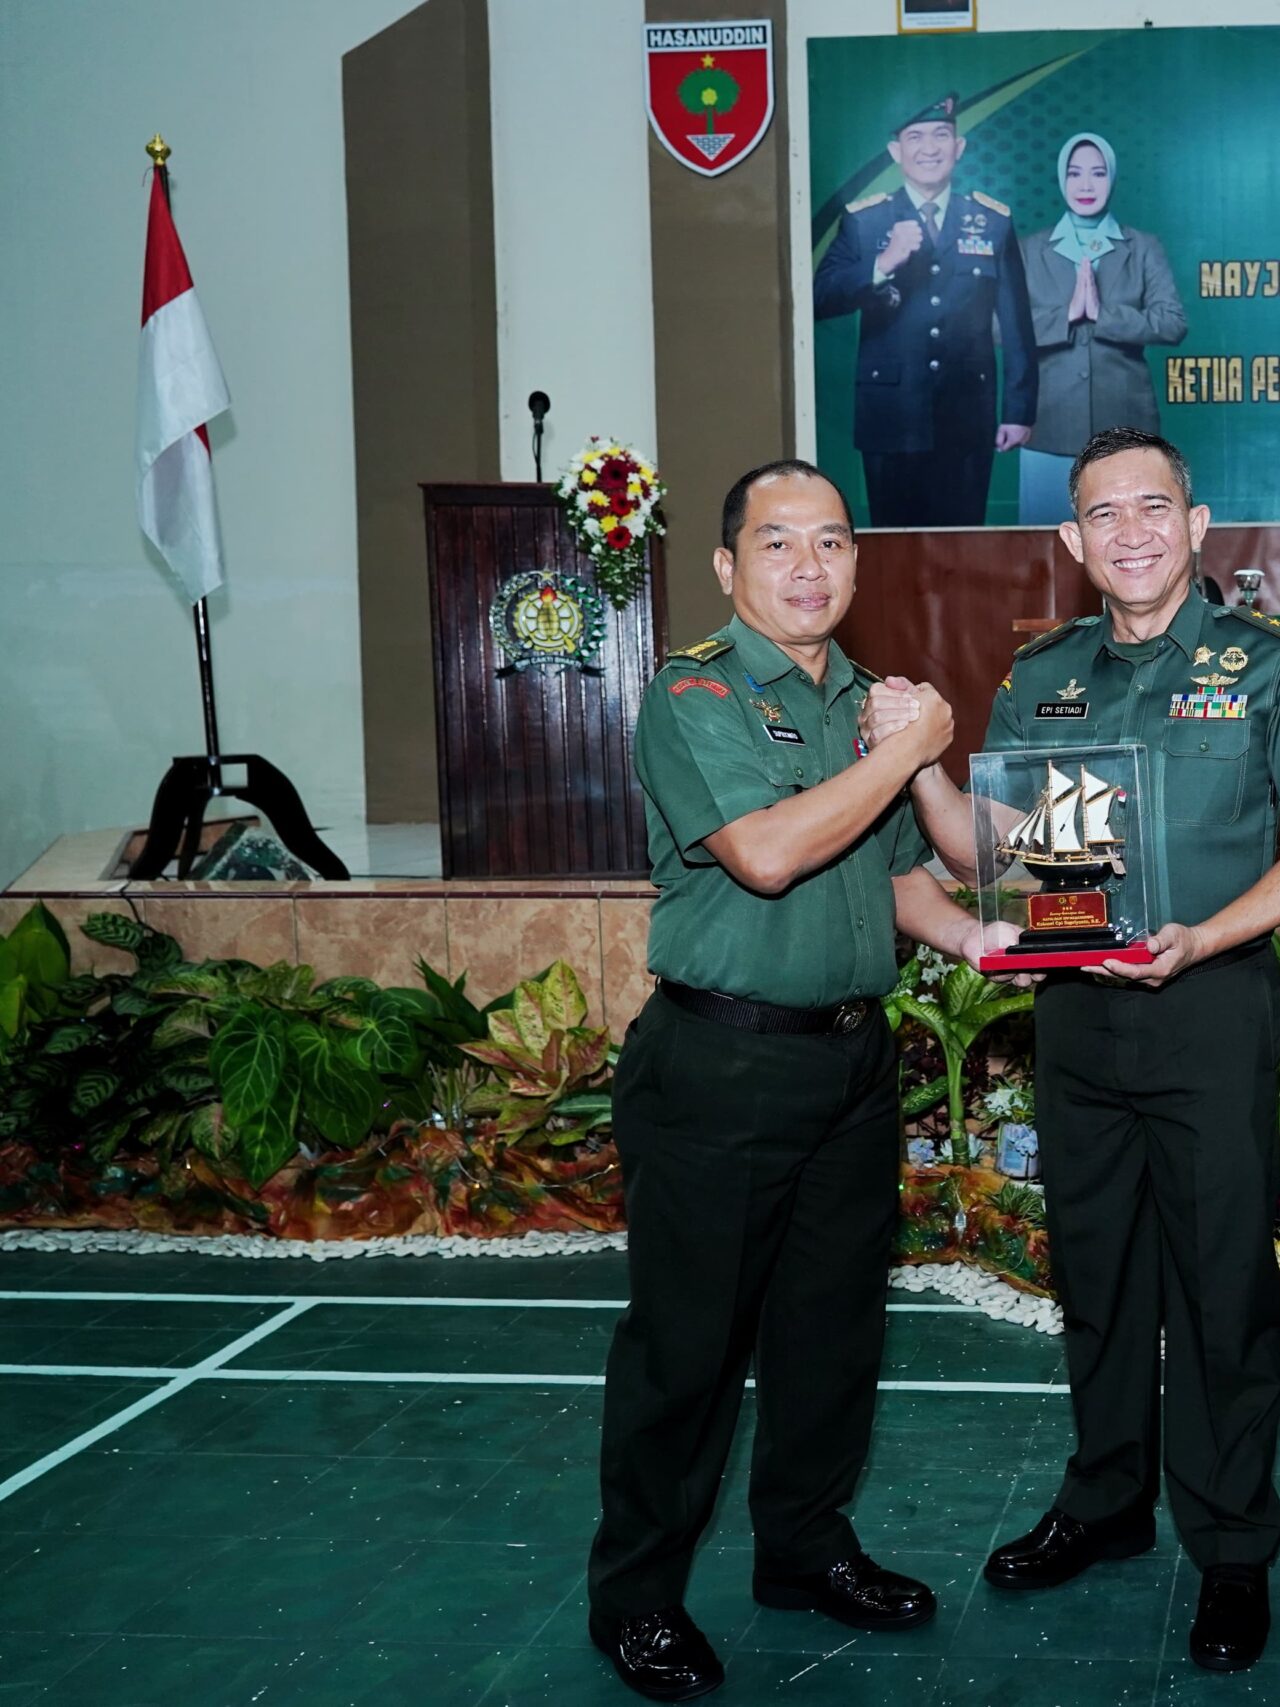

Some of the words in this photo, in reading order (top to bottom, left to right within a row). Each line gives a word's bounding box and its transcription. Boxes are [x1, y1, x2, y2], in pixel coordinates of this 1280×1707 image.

[649, 26, 764, 47] HASANUDDIN
[1167, 356, 1244, 402] KETUA
[1041, 706, 1053, 714] EPI
[1054, 706, 1083, 714] SETIADI
